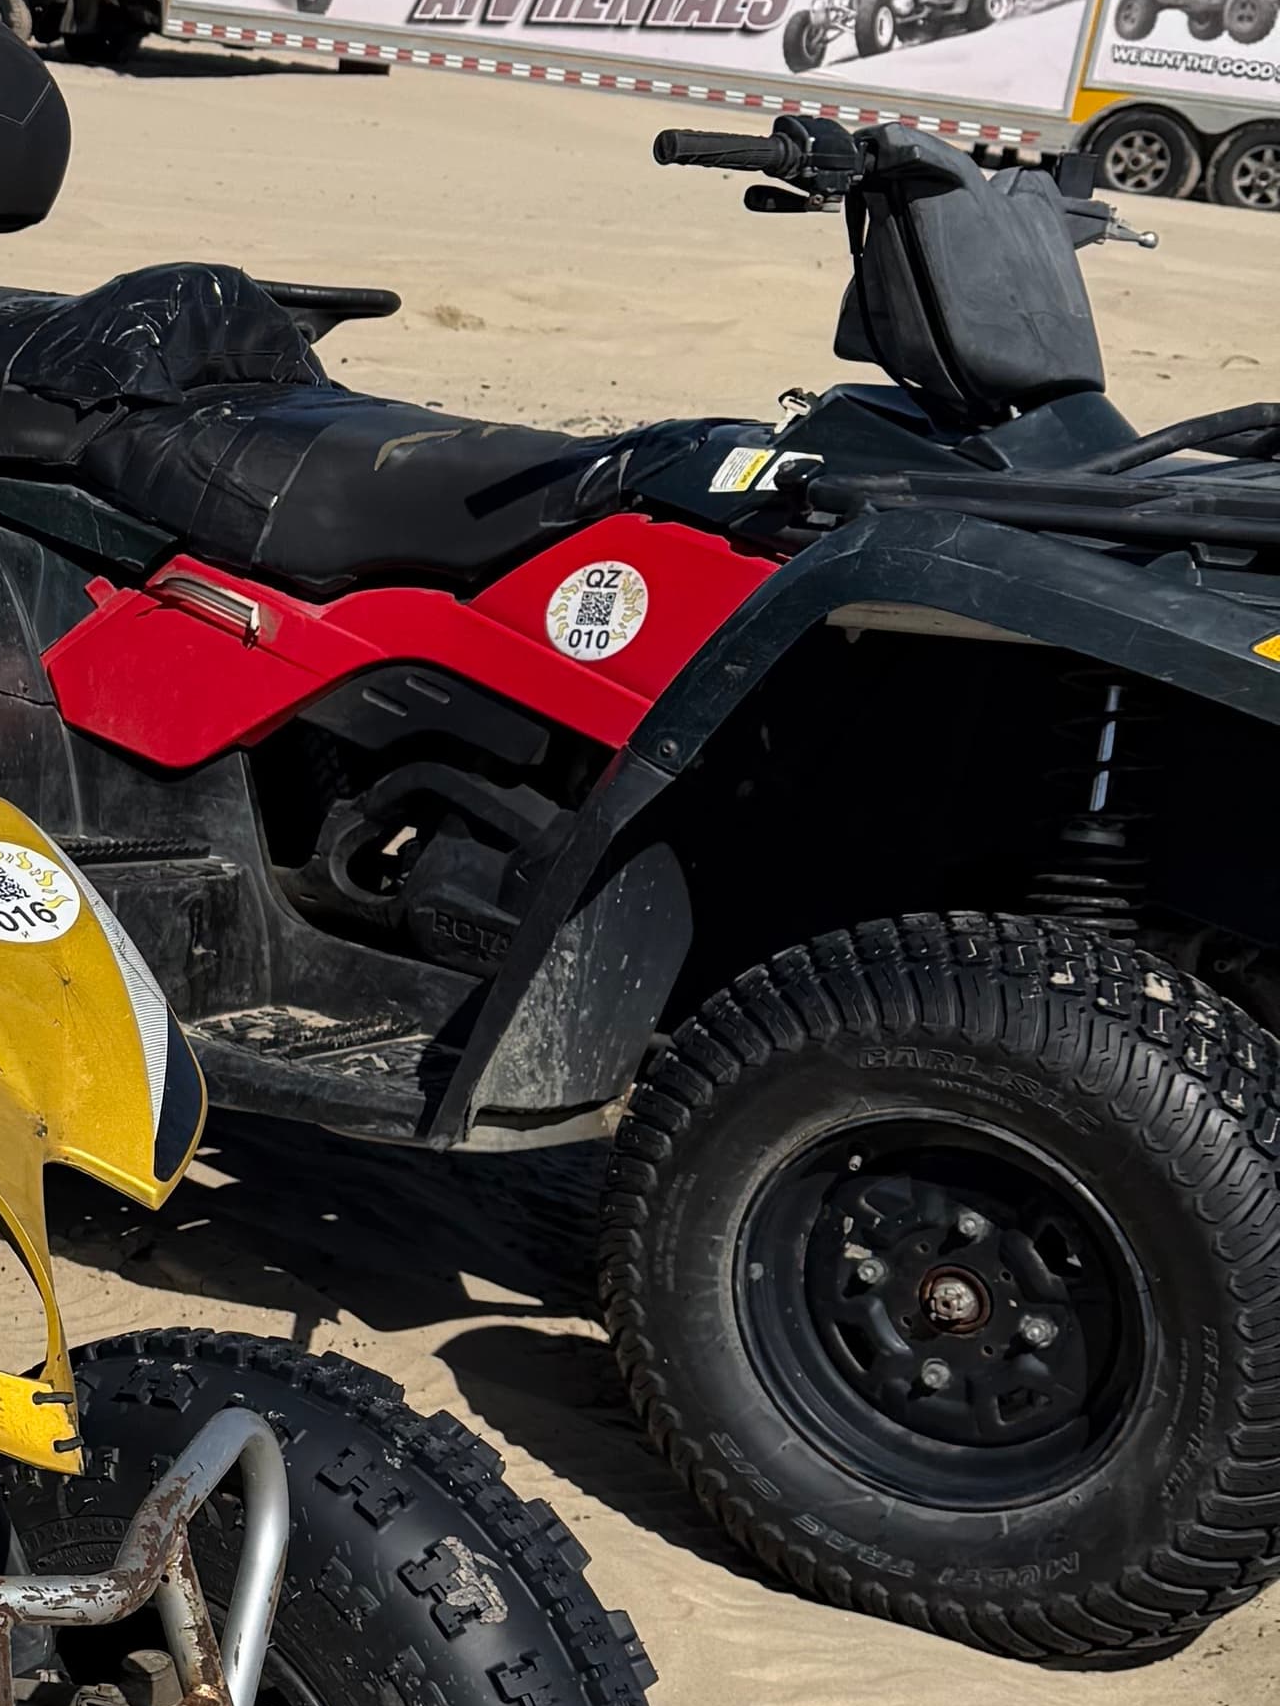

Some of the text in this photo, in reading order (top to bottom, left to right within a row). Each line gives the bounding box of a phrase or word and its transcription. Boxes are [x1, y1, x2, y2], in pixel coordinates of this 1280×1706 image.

[1140, 48, 1183, 69] RENT
[1217, 56, 1273, 81] GOOD
[585, 569, 623, 589] QZ
[568, 628, 610, 650] 010
